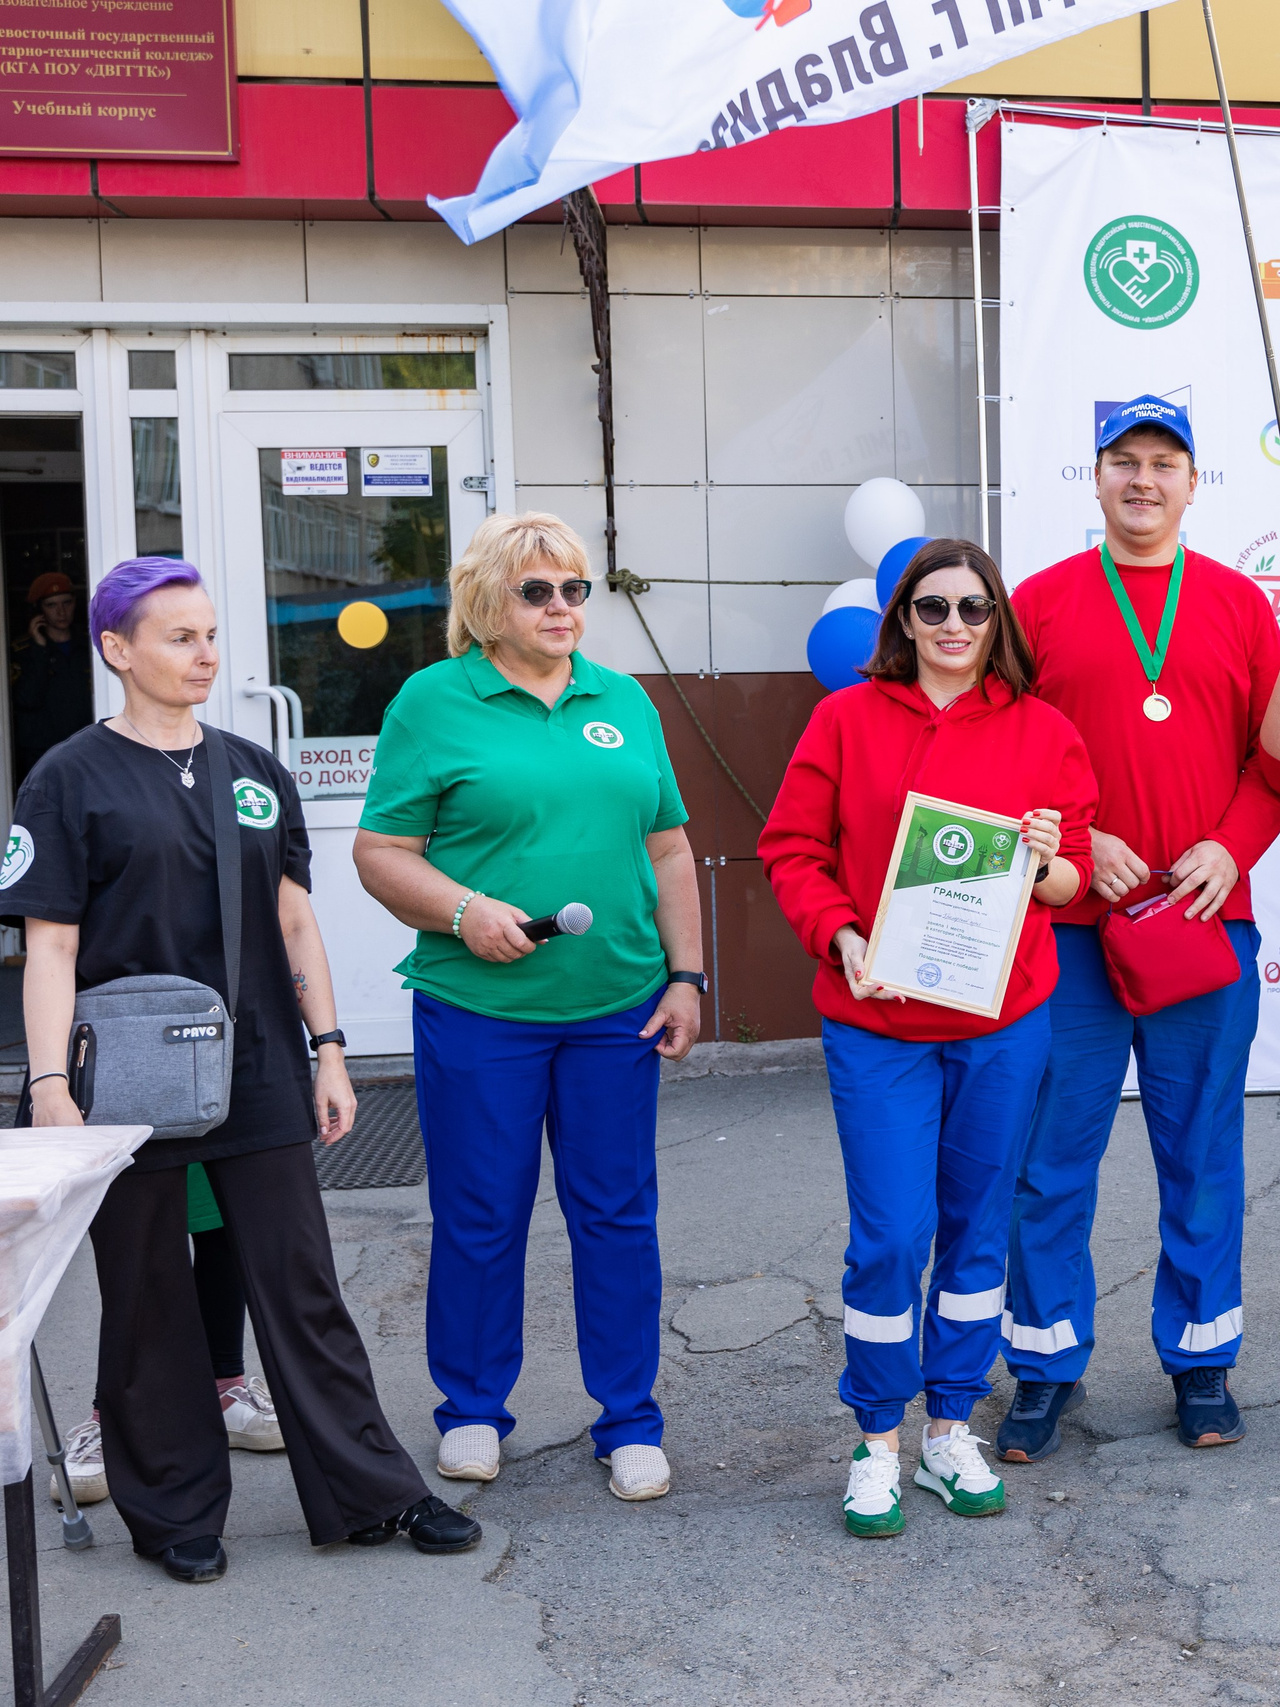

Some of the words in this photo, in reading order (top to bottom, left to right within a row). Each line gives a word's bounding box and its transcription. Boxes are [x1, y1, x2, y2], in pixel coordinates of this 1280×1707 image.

[92, 0, 174, 12] учреждение
[90, 32, 216, 45] государственный
[145, 51, 214, 62] колледж»
[1, 61, 41, 76] (КГА
[44, 62, 81, 76] ПОУ
[85, 64, 172, 80] «ДВГГТК»)
[12, 100, 92, 117] Учебный
[97, 105, 157, 121] корпус
[1121, 402, 1176, 418] ПРИМОРСКИЙ
[1135, 410, 1163, 419] ПУЛЬС
[284, 451, 344, 459] ВНИМАНИЕ!
[309, 463, 343, 472] ВЕДЕТСЯ
[300, 750, 353, 765] ВХОД
[318, 769, 371, 787] ДОКУ
[933, 886, 983, 906] ГРАМОТА
[183, 1025, 217, 1038] PAVO
